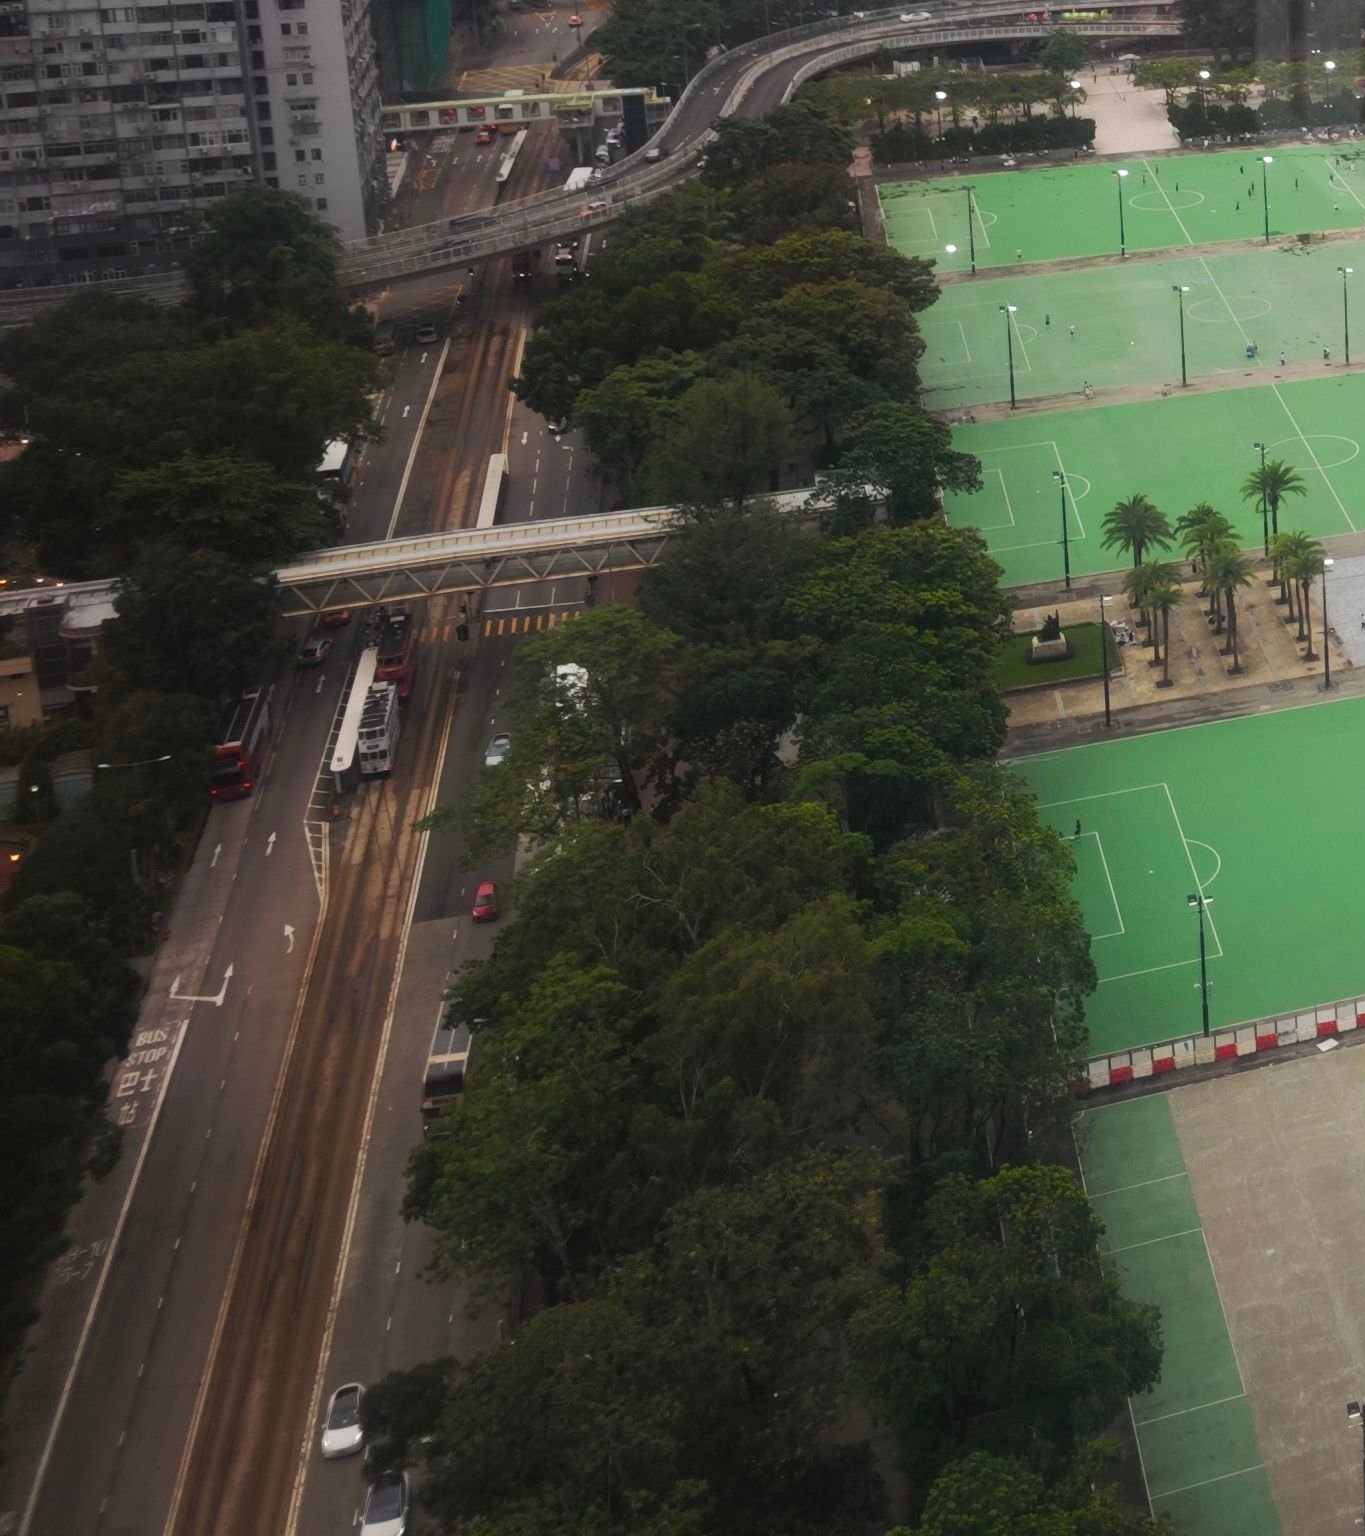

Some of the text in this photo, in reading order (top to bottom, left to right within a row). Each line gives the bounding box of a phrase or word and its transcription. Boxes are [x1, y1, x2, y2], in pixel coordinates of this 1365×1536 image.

[137, 1030, 168, 1047] BUS
[126, 1048, 166, 1067] STOP
[118, 1069, 156, 1097] 巴士
